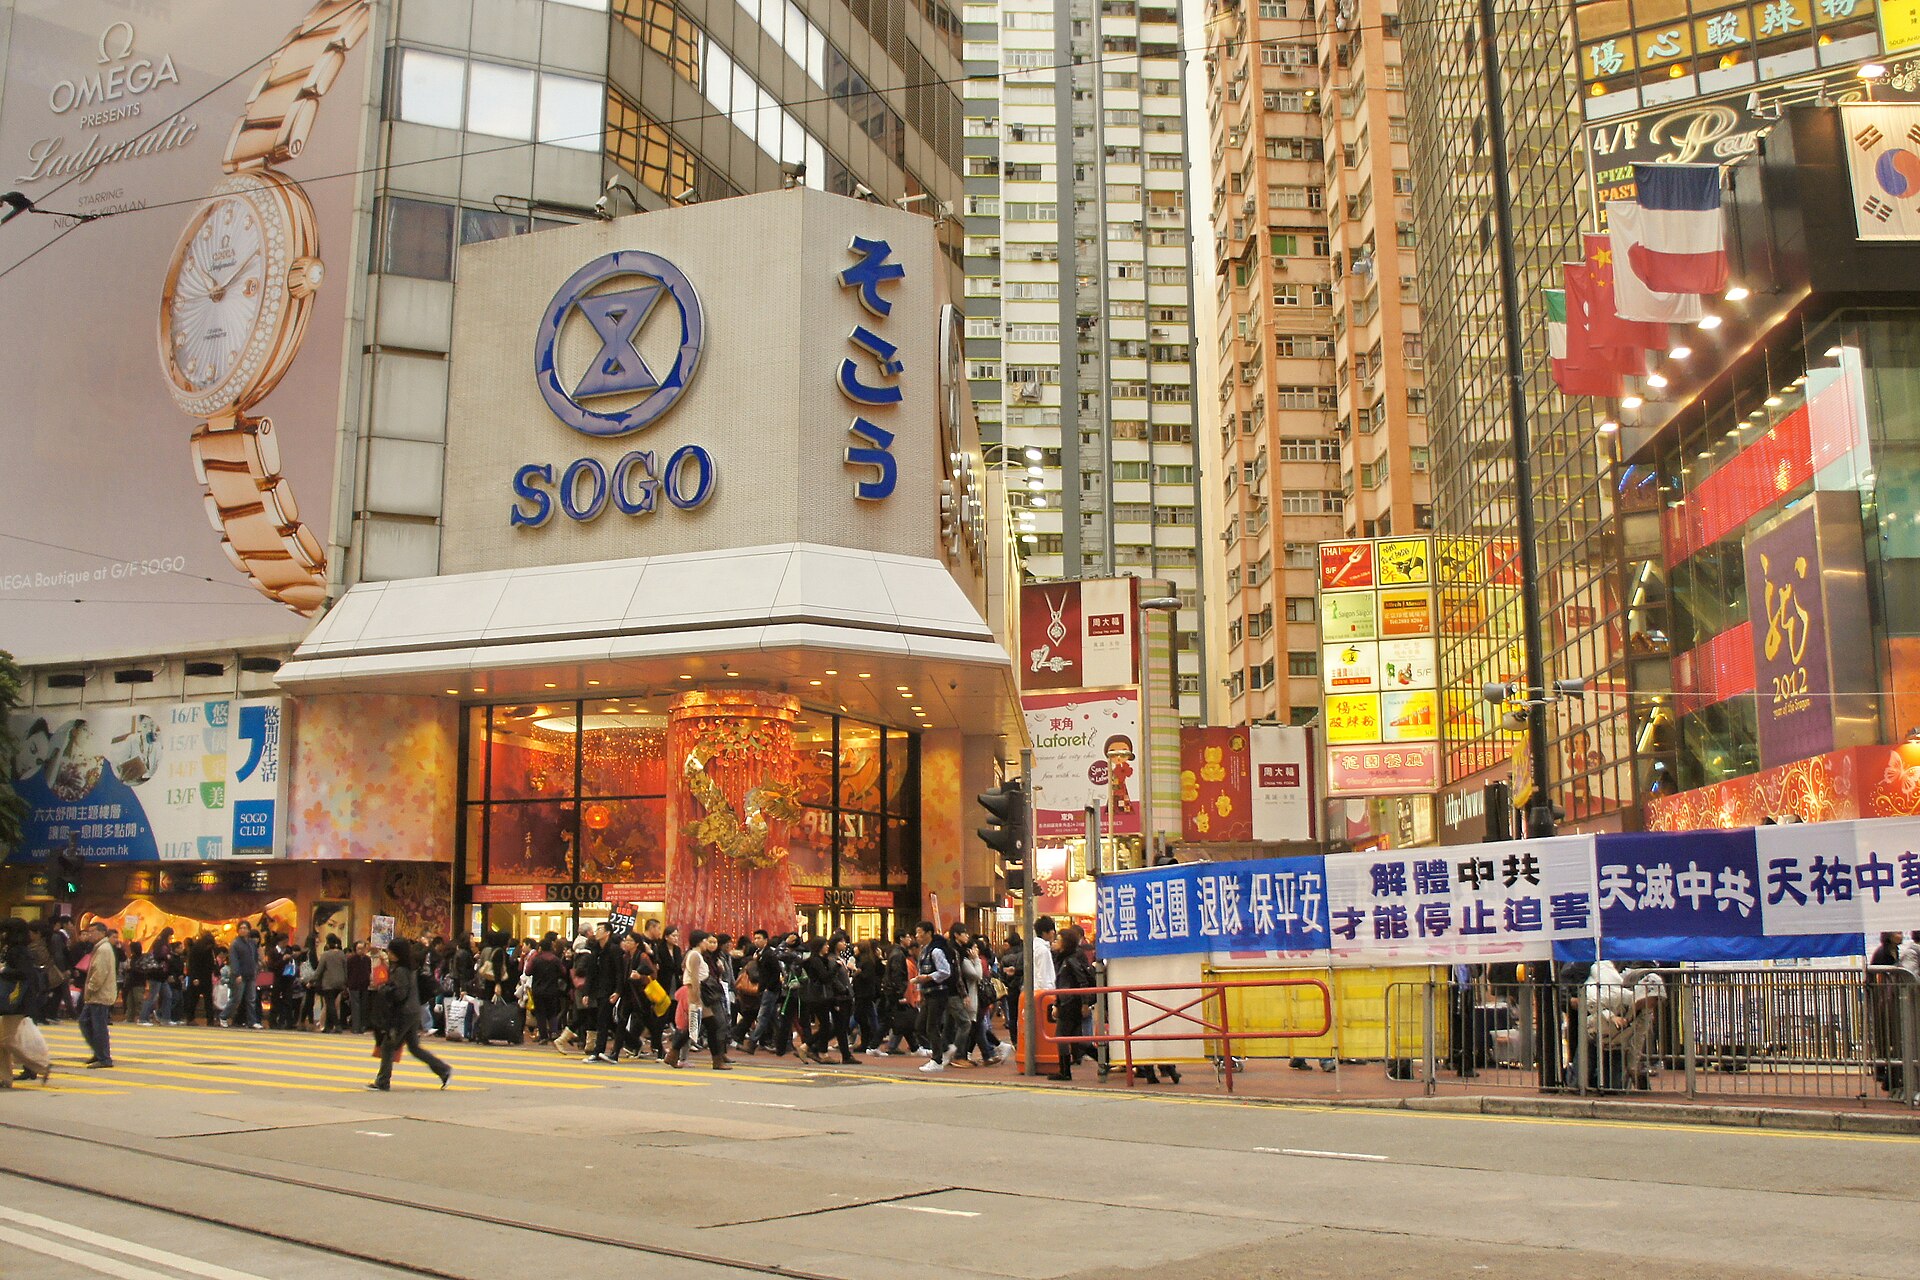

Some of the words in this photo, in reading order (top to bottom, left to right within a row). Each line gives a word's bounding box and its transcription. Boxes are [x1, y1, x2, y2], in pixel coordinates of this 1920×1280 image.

[50, 54, 180, 113] OMEGA
[79, 102, 141, 129] PRESENTS
[1593, 120, 1641, 156] 4/F
[14, 115, 199, 184] Ladymatic
[1596, 165, 1635, 185] PIZZ
[78, 188, 124, 208] STARRING
[1598, 183, 1638, 203] PAST
[836, 234, 906, 502] そごう
[510, 443, 718, 530] SOGO
[0, 574, 32, 591] EGA
[35, 568, 90, 588] Boutique
[94, 566, 107, 581] at
[111, 562, 138, 579] G/F
[141, 555, 185, 576] SOGO
[1339, 611, 1355, 619] Saigon
[1772, 666, 1808, 704] 2012
[170, 706, 201, 725] 16/F
[211, 704, 228, 724] 悠
[1049, 717, 1074, 732] 東角
[1036, 731, 1087, 749] Laforet
[167, 787, 197, 805] 13/F
[209, 786, 224, 807] 美
[240, 812, 268, 824] SOGO
[239, 824, 267, 836] CLUB
[164, 842, 193, 859] 11/F
[547, 884, 600, 900] SOGO
[824, 889, 855, 905] SOGO
[1599, 860, 1757, 919] 天滅中共
[1097, 883, 1139, 945] 退黨
[1146, 877, 1190, 941] 退團
[1197, 874, 1243, 938] 退隊
[1248, 870, 1325, 936] 保平安
[1331, 891, 1592, 941] 才能停止迫害
